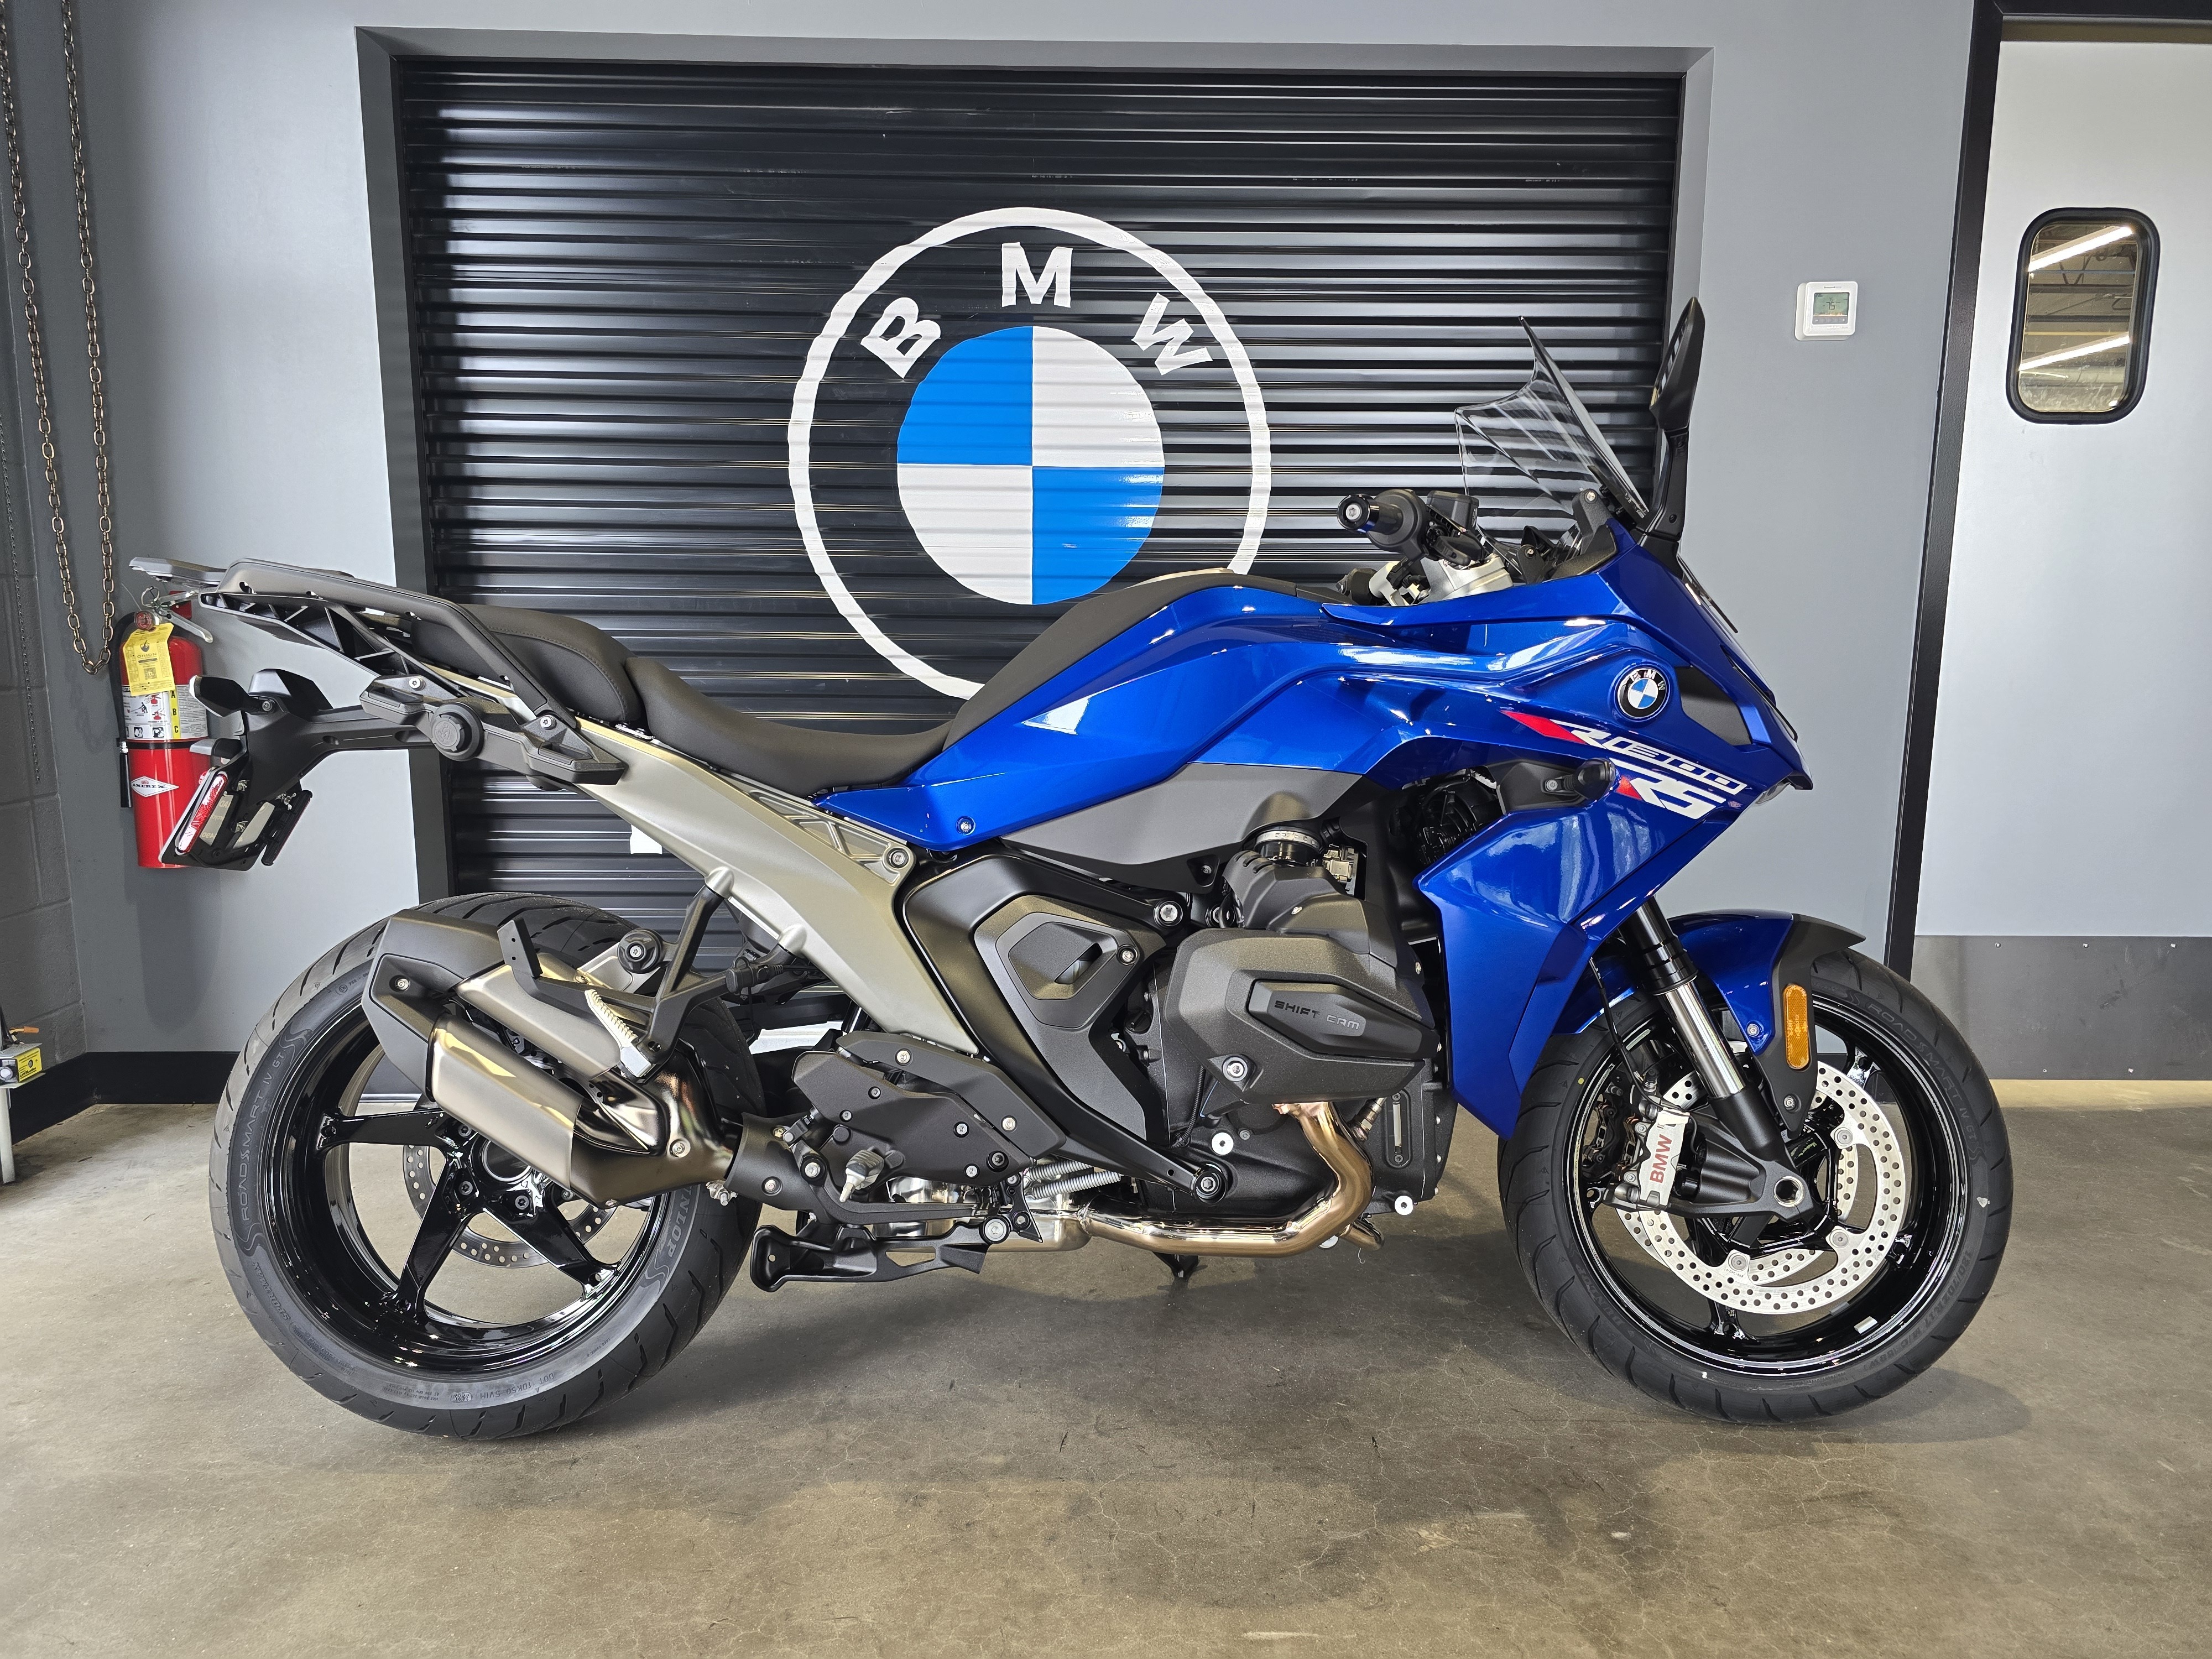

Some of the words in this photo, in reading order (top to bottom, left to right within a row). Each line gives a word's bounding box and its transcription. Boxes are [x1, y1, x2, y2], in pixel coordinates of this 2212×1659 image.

[860, 242, 1213, 379] BMW
[1825, 301, 1835, 310] 75
[1630, 669, 1666, 691] BMW
[1610, 757, 1726, 819] RS
[1274, 1000, 1321, 1019] SHIFT
[1326, 1014, 1360, 1030] CAM
[263, 1070, 272, 1085] IV
[272, 1052, 286, 1071] GT
[1650, 1134, 1672, 1183] BMW
[667, 1186, 692, 1258] NLOP
[253, 1262, 291, 1322] SPORTMAX
[538, 1372, 555, 1384] DOT
